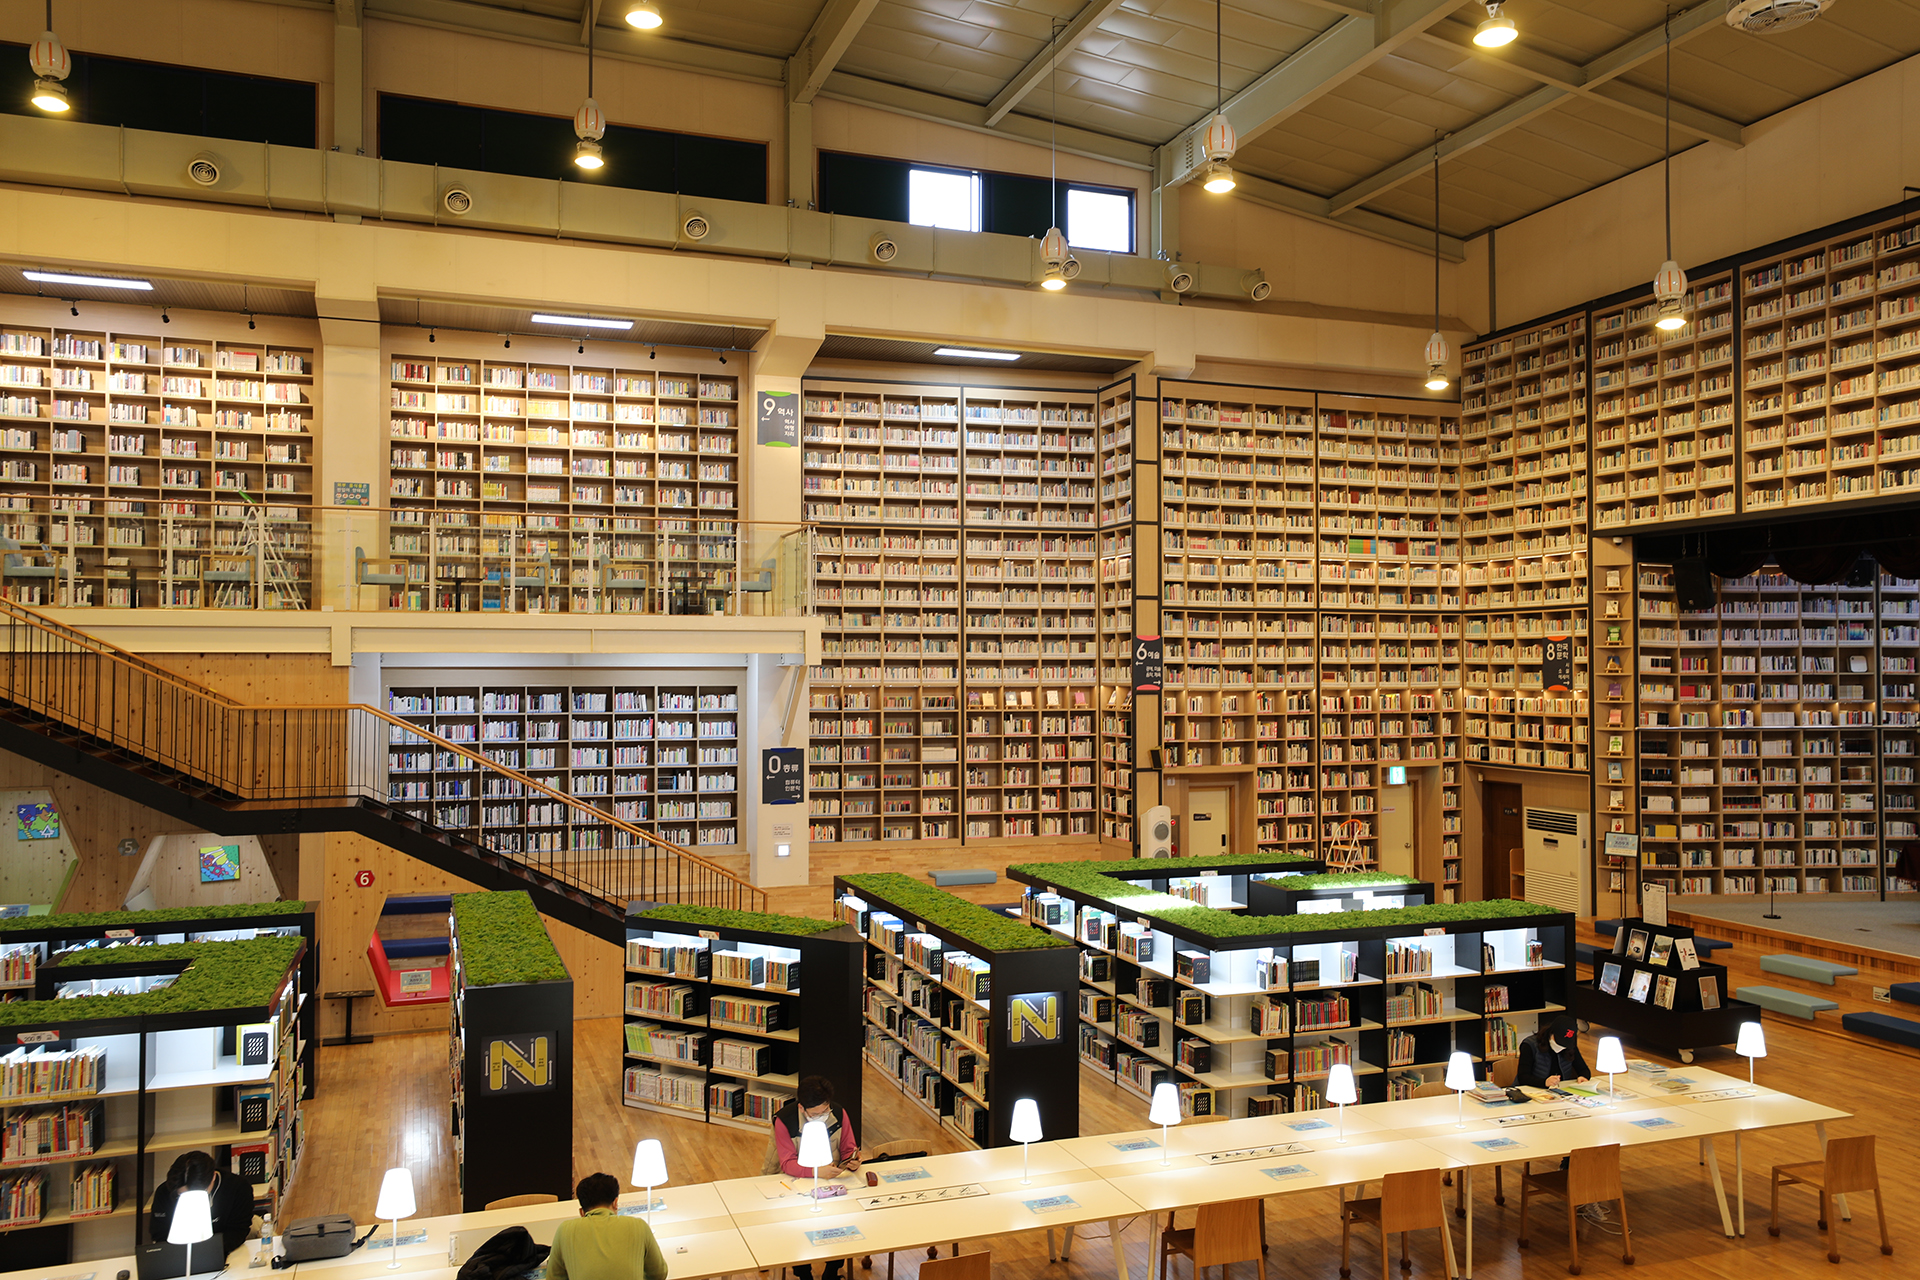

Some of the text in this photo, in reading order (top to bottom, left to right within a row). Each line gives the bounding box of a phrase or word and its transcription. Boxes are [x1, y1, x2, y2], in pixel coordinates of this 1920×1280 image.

[763, 398, 794, 417] 9 역사
[1136, 643, 1160, 660] 6 예술
[1546, 643, 1569, 661] 8 한국
[1556, 651, 1569, 660] 문학
[768, 755, 799, 774] 0 총류
[125, 841, 133, 854] 5
[360, 872, 370, 886] 6
[1011, 995, 1057, 1043] N
[489, 1036, 548, 1091] N
